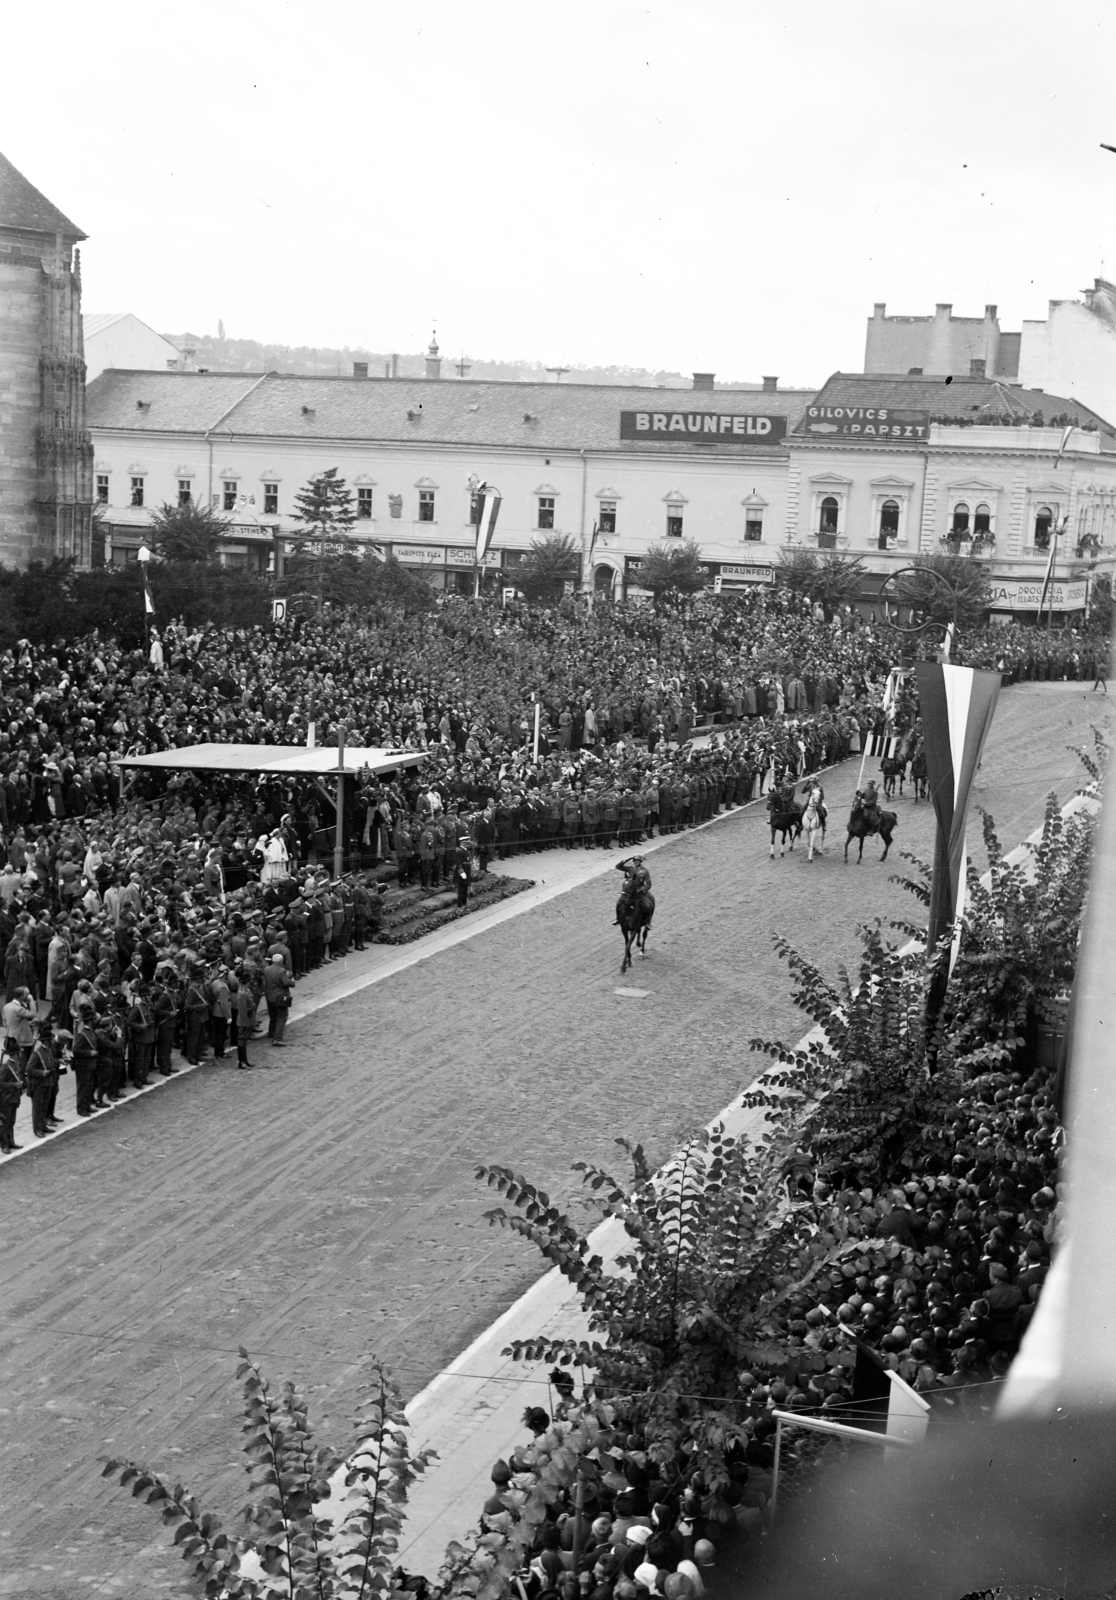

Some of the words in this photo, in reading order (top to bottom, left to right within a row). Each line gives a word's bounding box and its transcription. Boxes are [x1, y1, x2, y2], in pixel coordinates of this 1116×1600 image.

[808, 407, 888, 420] GILOVICS
[636, 413, 772, 435] BRAUNFELD
[851, 424, 926, 437] PAPSZT
[722, 566, 771, 576] BRAUNFELD
[1018, 586, 1063, 595] DROGRIA
[275, 602, 285, 620] D
